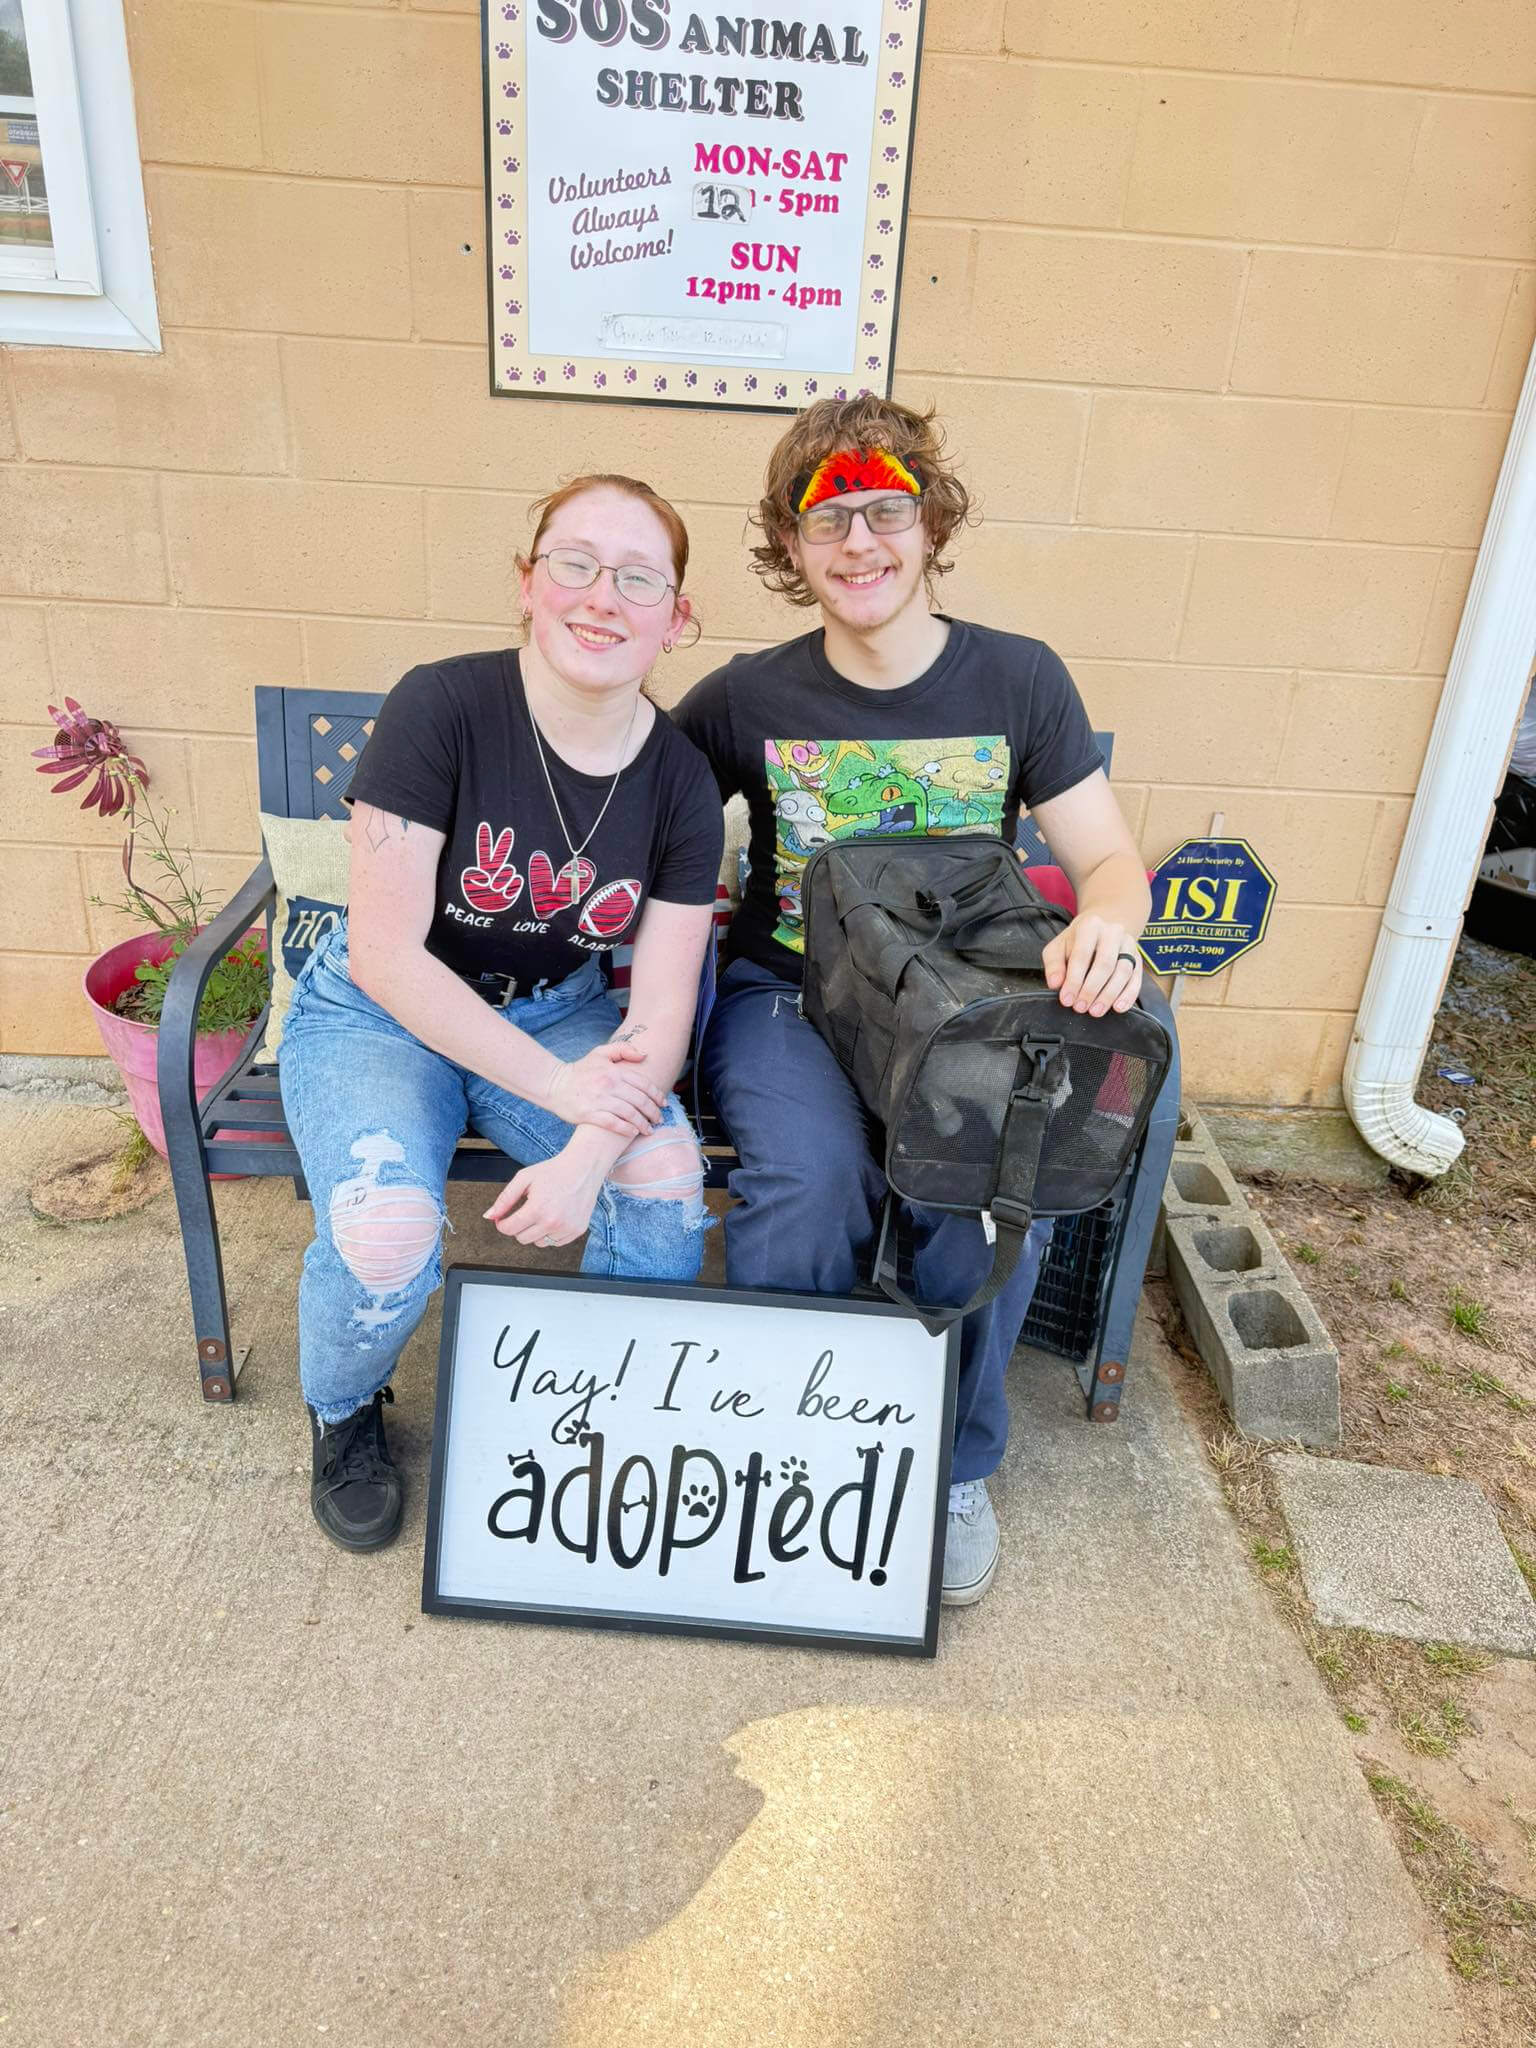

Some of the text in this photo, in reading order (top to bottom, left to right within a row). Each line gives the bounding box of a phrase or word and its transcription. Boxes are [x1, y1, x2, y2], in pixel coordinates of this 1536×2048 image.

[536, 0, 869, 66] SOS ANIMAL
[596, 68, 805, 121] SHELTER
[694, 143, 848, 182] MON-SAT
[548, 166, 672, 204] Volunteers
[697, 185, 746, 222] 12
[779, 189, 839, 216] 5pm
[572, 204, 659, 236] Always
[570, 229, 674, 271] Welcome!
[731, 242, 801, 273] SUN
[686, 277, 761, 304] 12pm
[783, 283, 842, 309] 4pm
[1205, 857, 1233, 867] Security
[1234, 857, 1245, 867] By
[1158, 877, 1248, 922] ISI
[445, 903, 494, 928] PEACE
[512, 920, 550, 934] LOVE
[1142, 925, 1195, 936] NTERNATIONAL
[1156, 944, 1225, 956] 334-673-3900
[493, 1324, 916, 1444] Yay! I've been
[486, 1430, 915, 1588] adopted!
